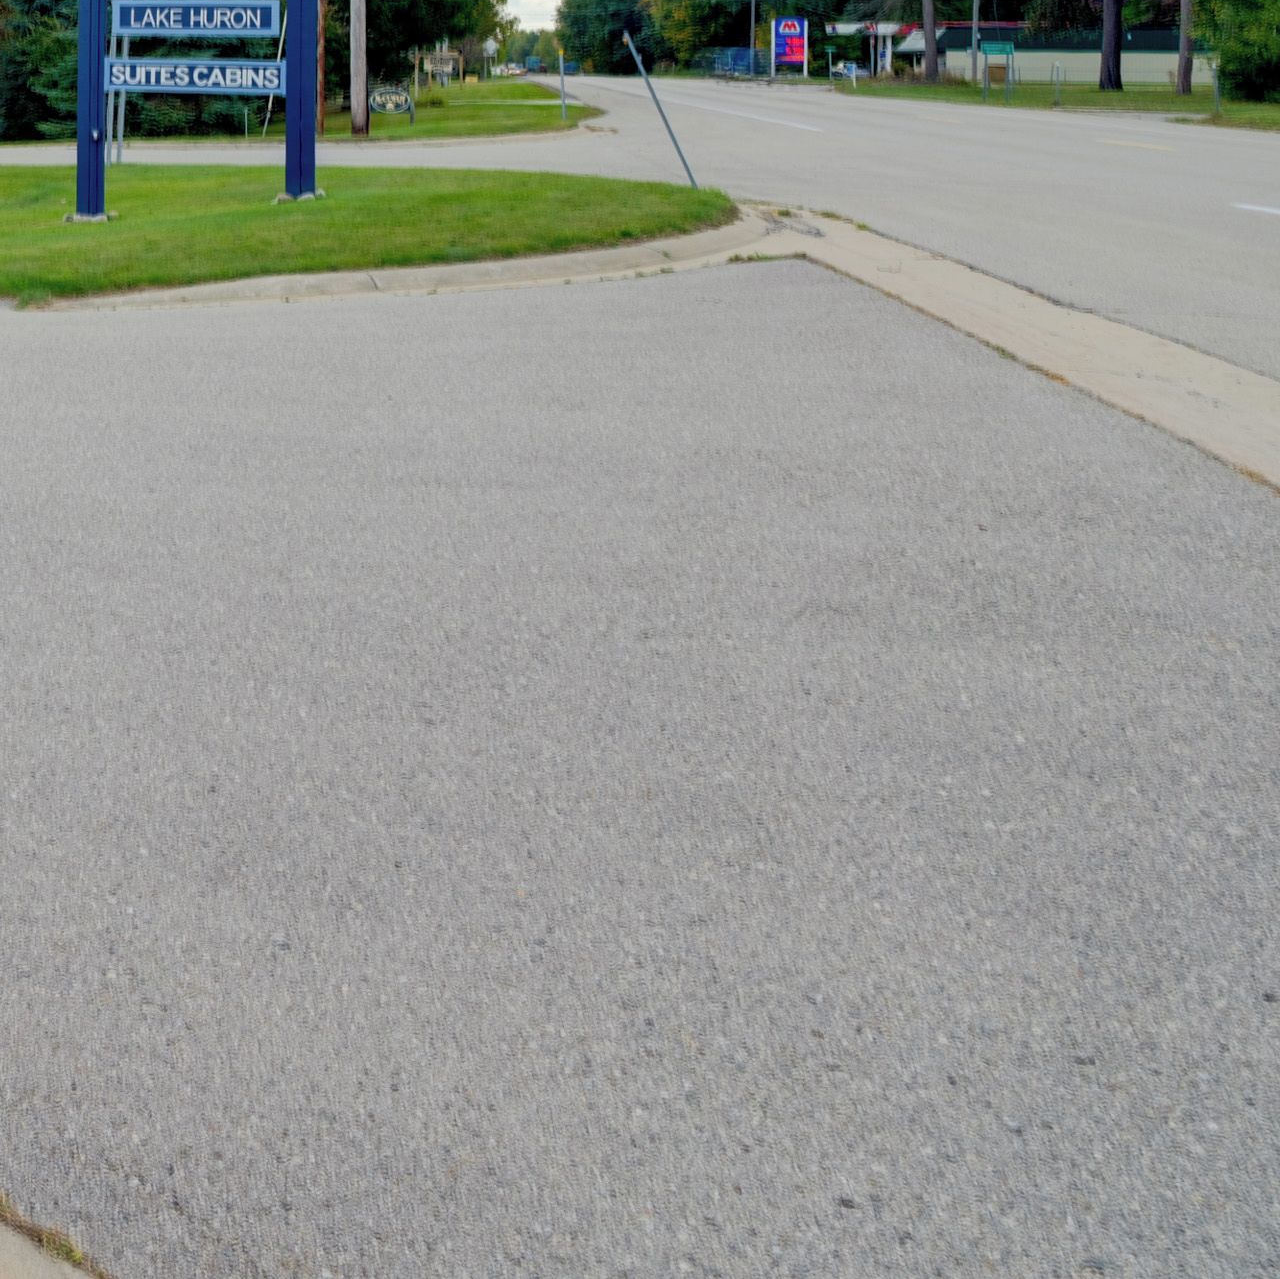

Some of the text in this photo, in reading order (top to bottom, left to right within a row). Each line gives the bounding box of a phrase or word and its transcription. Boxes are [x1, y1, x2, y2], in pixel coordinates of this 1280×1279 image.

[130, 8, 261, 29] LAKE HURON
[111, 65, 279, 89] SUITES CABINS
